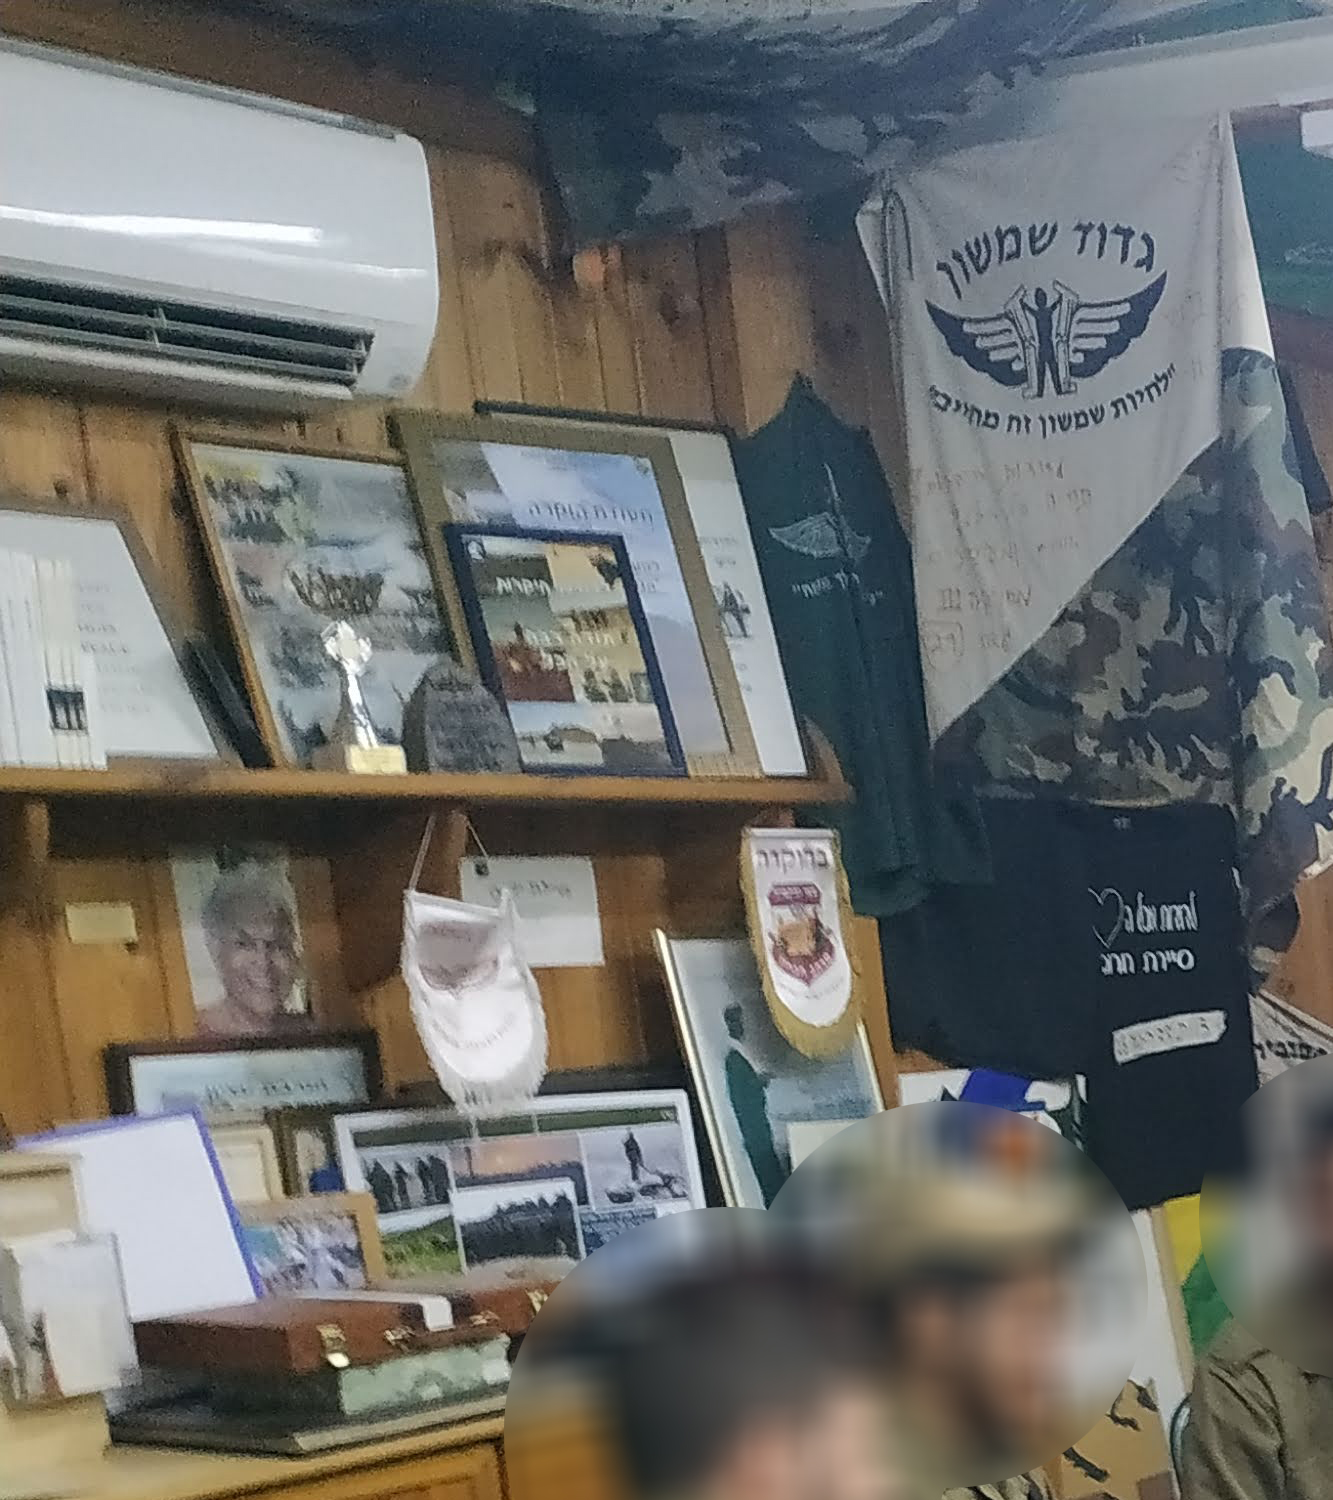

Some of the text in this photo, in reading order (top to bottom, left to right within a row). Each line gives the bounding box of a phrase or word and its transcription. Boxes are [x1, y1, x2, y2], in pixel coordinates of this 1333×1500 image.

[936, 221, 1155, 300] גדוד שמשון
[1039, 403, 1105, 439] שמשון
